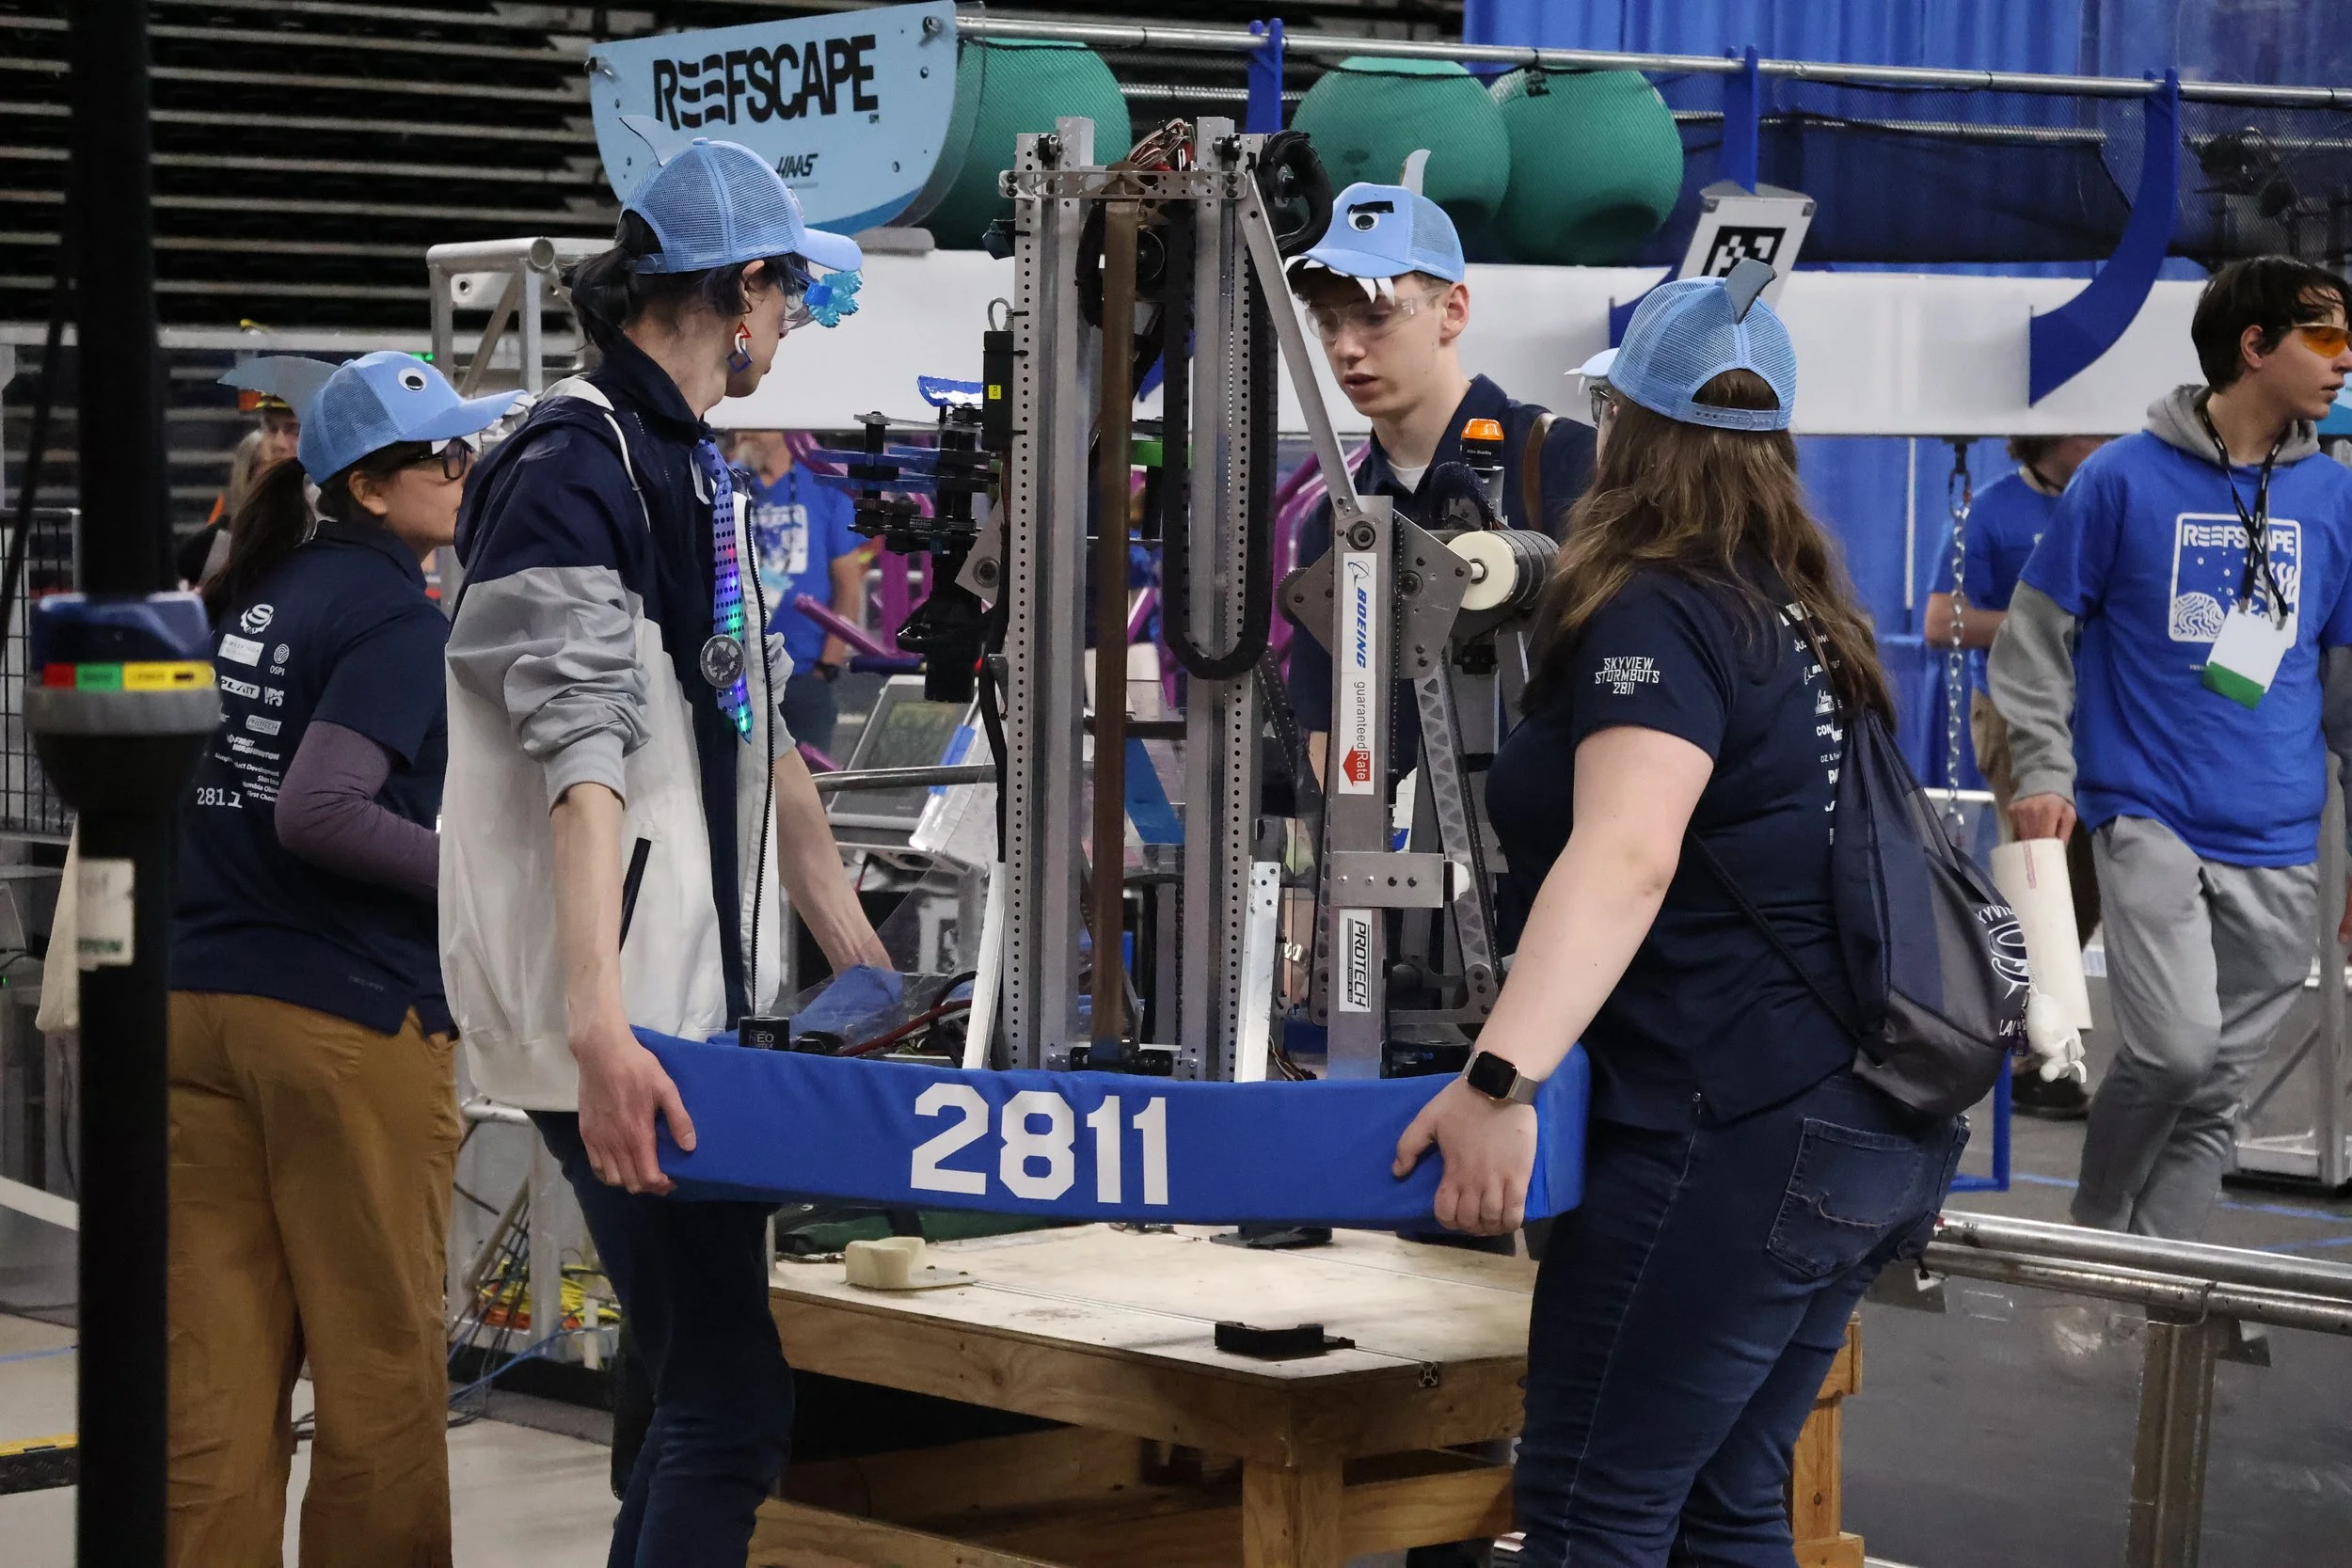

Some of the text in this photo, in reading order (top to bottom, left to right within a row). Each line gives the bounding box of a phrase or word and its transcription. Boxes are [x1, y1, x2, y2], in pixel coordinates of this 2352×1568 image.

[653, 34, 879, 130] REEFSCAPE
[2183, 524, 2296, 556] REEFSAPE
[1356, 587, 1367, 669] BOEING
[269, 665, 285, 676] OSPI
[1595, 669, 1661, 685] STORMBOTS
[1603, 656, 1654, 671] SKYVIEW
[1613, 681, 1635, 695] 2811
[1353, 681, 1369, 781] guaranteed Rate
[197, 787, 243, 809] 2811
[1354, 920, 1367, 1008] PROTECH
[910, 1082, 1168, 1205] 2811
